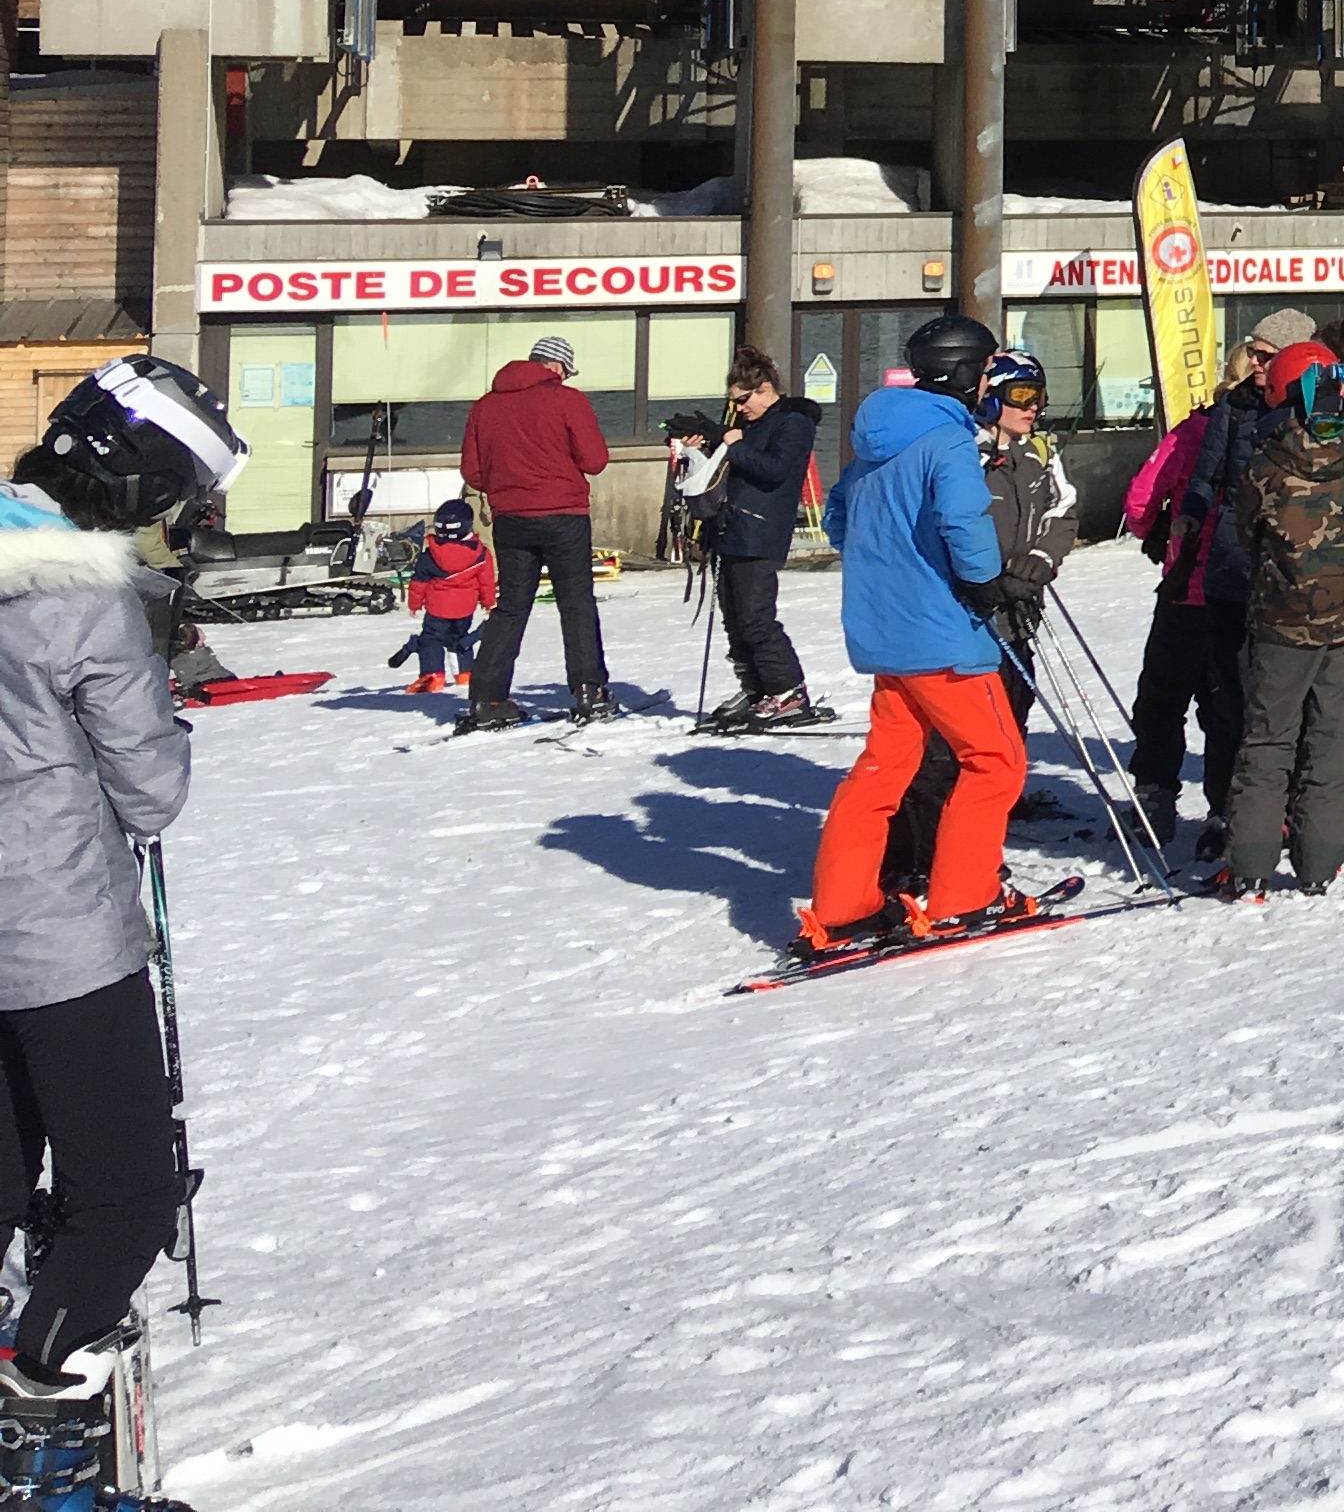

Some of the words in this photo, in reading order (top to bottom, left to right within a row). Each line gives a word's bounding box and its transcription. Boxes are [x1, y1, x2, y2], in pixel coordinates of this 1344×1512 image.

[211, 271, 386, 301] POSTE
[410, 269, 476, 298] DE
[499, 264, 737, 296] SECOURS
[986, 905, 1005, 915] EVO
